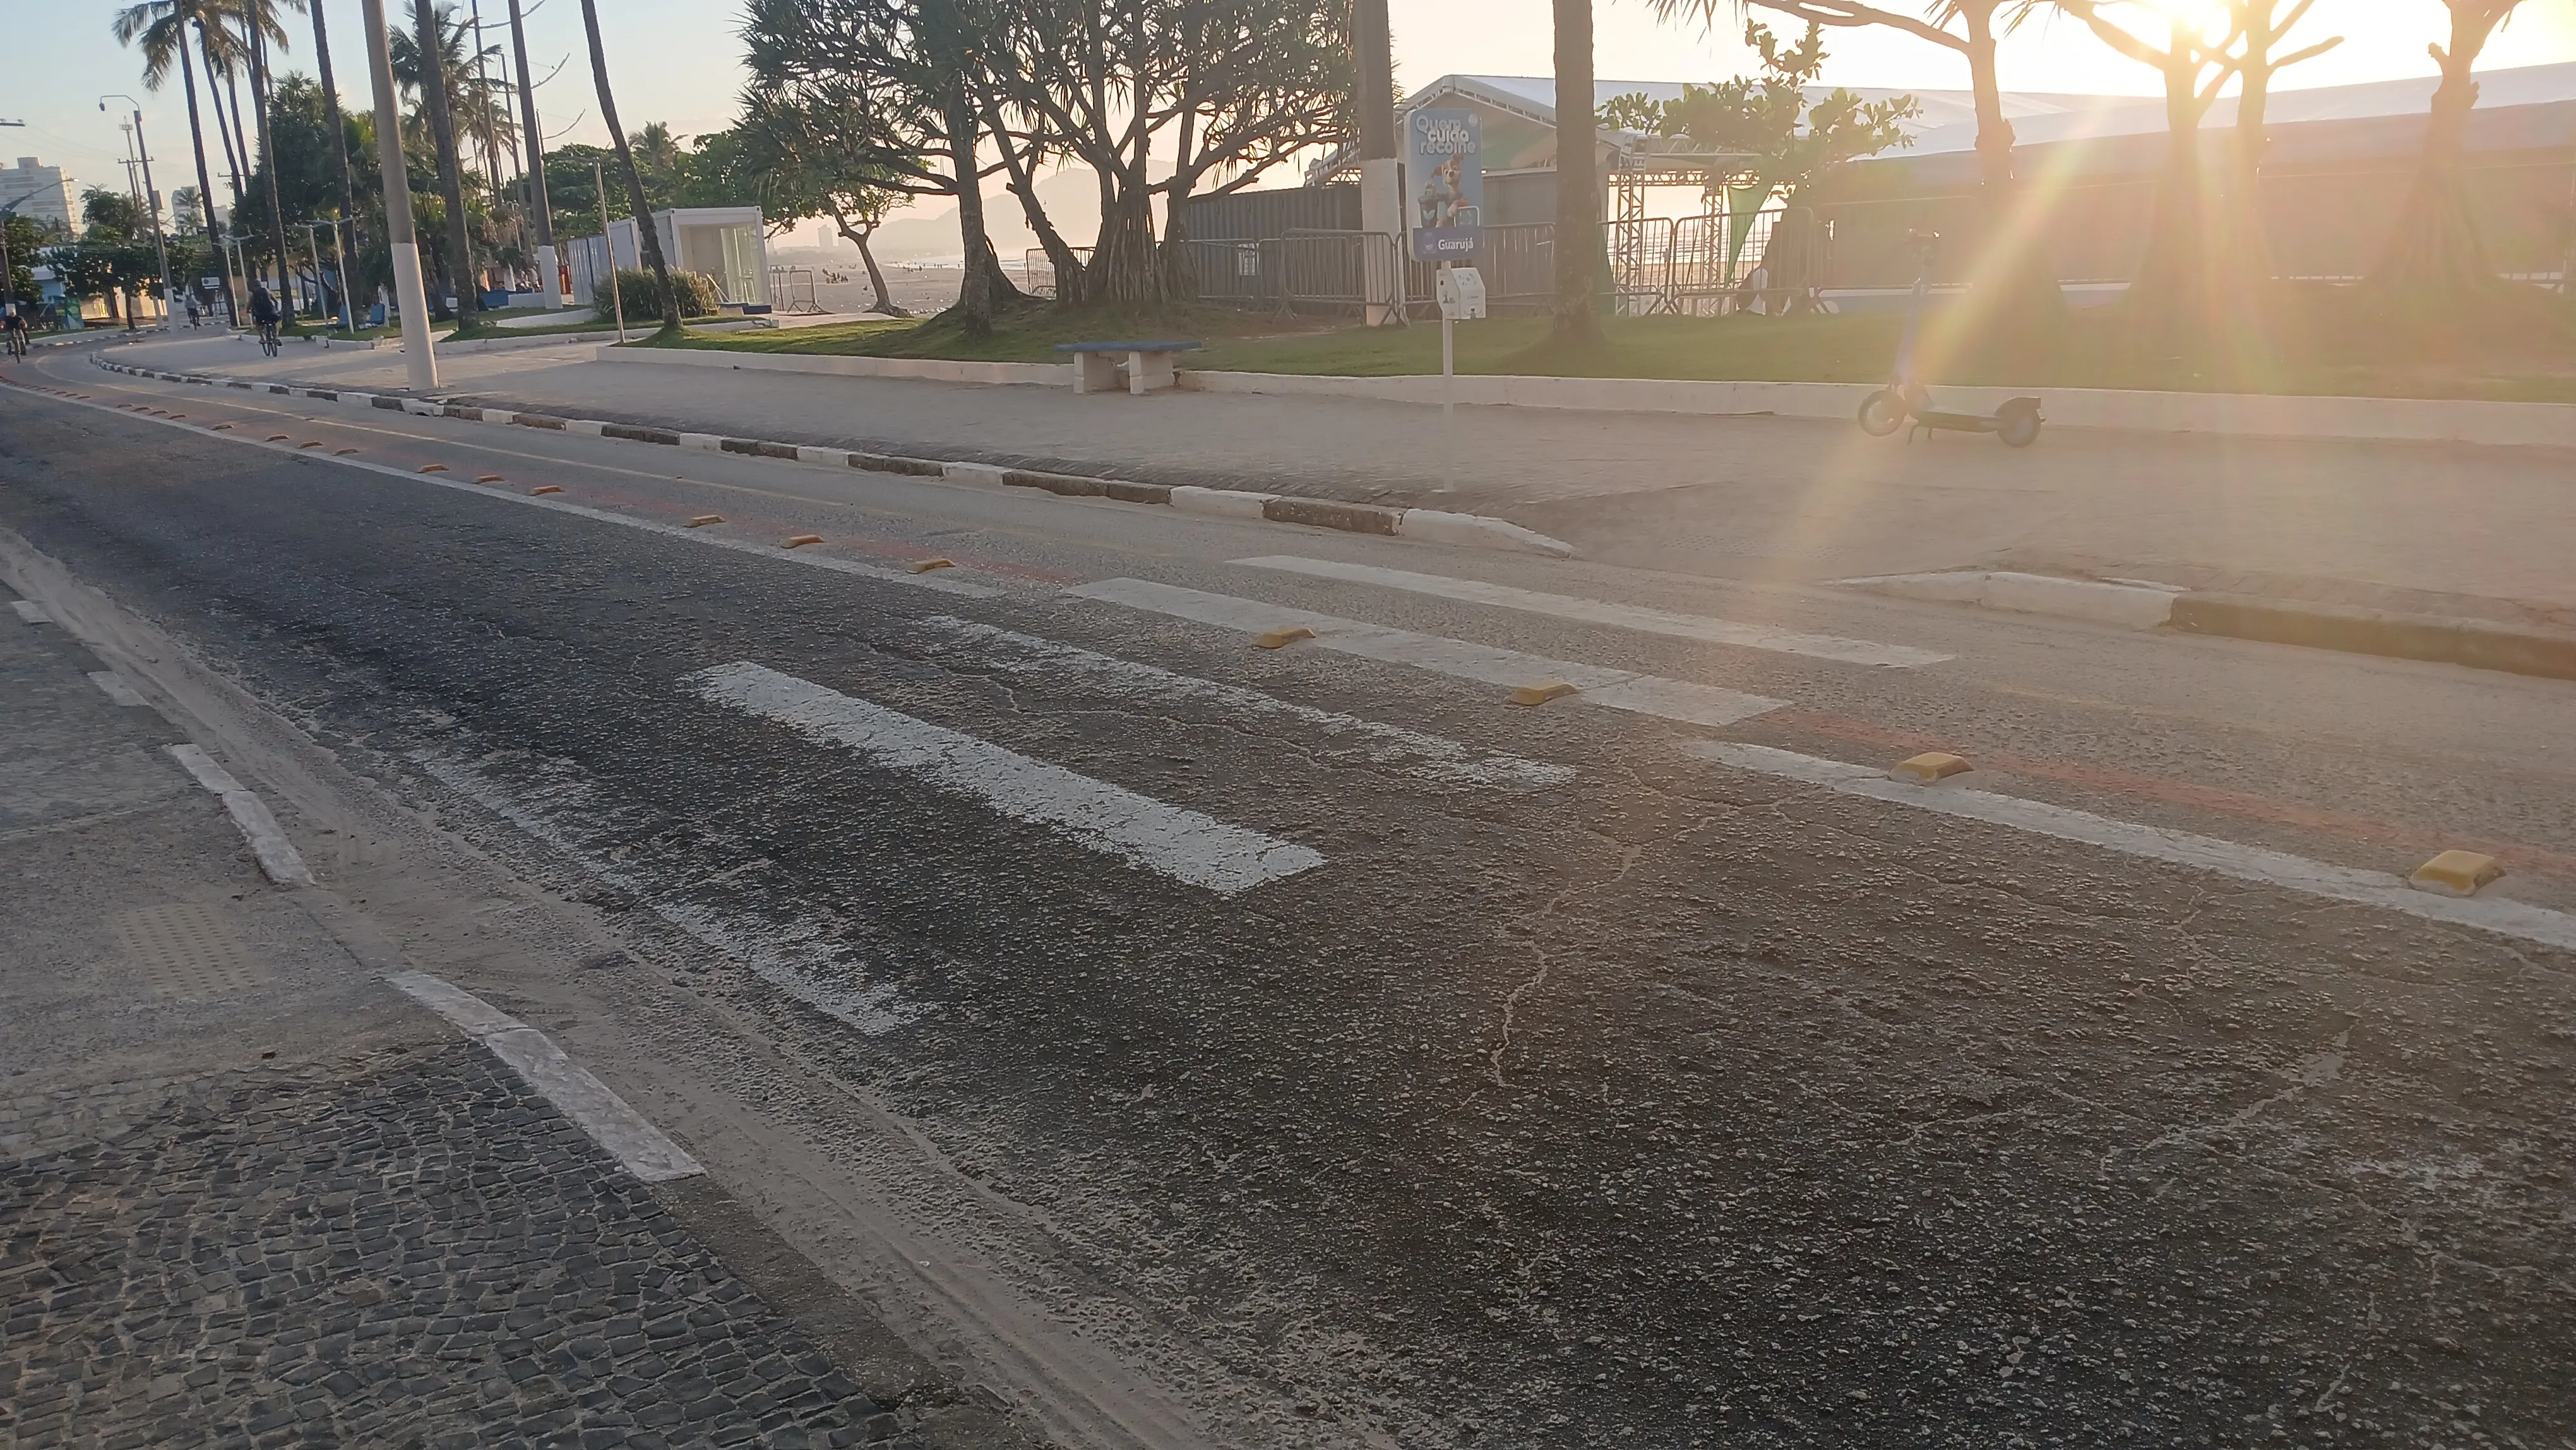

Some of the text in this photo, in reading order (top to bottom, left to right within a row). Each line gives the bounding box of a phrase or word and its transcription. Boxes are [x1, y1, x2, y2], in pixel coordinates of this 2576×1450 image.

[1416, 115, 1461, 133] Quem
[1428, 128, 1469, 142] cuida
[1420, 138, 1476, 154] recolhe
[1438, 237, 1474, 252] Guarujá
